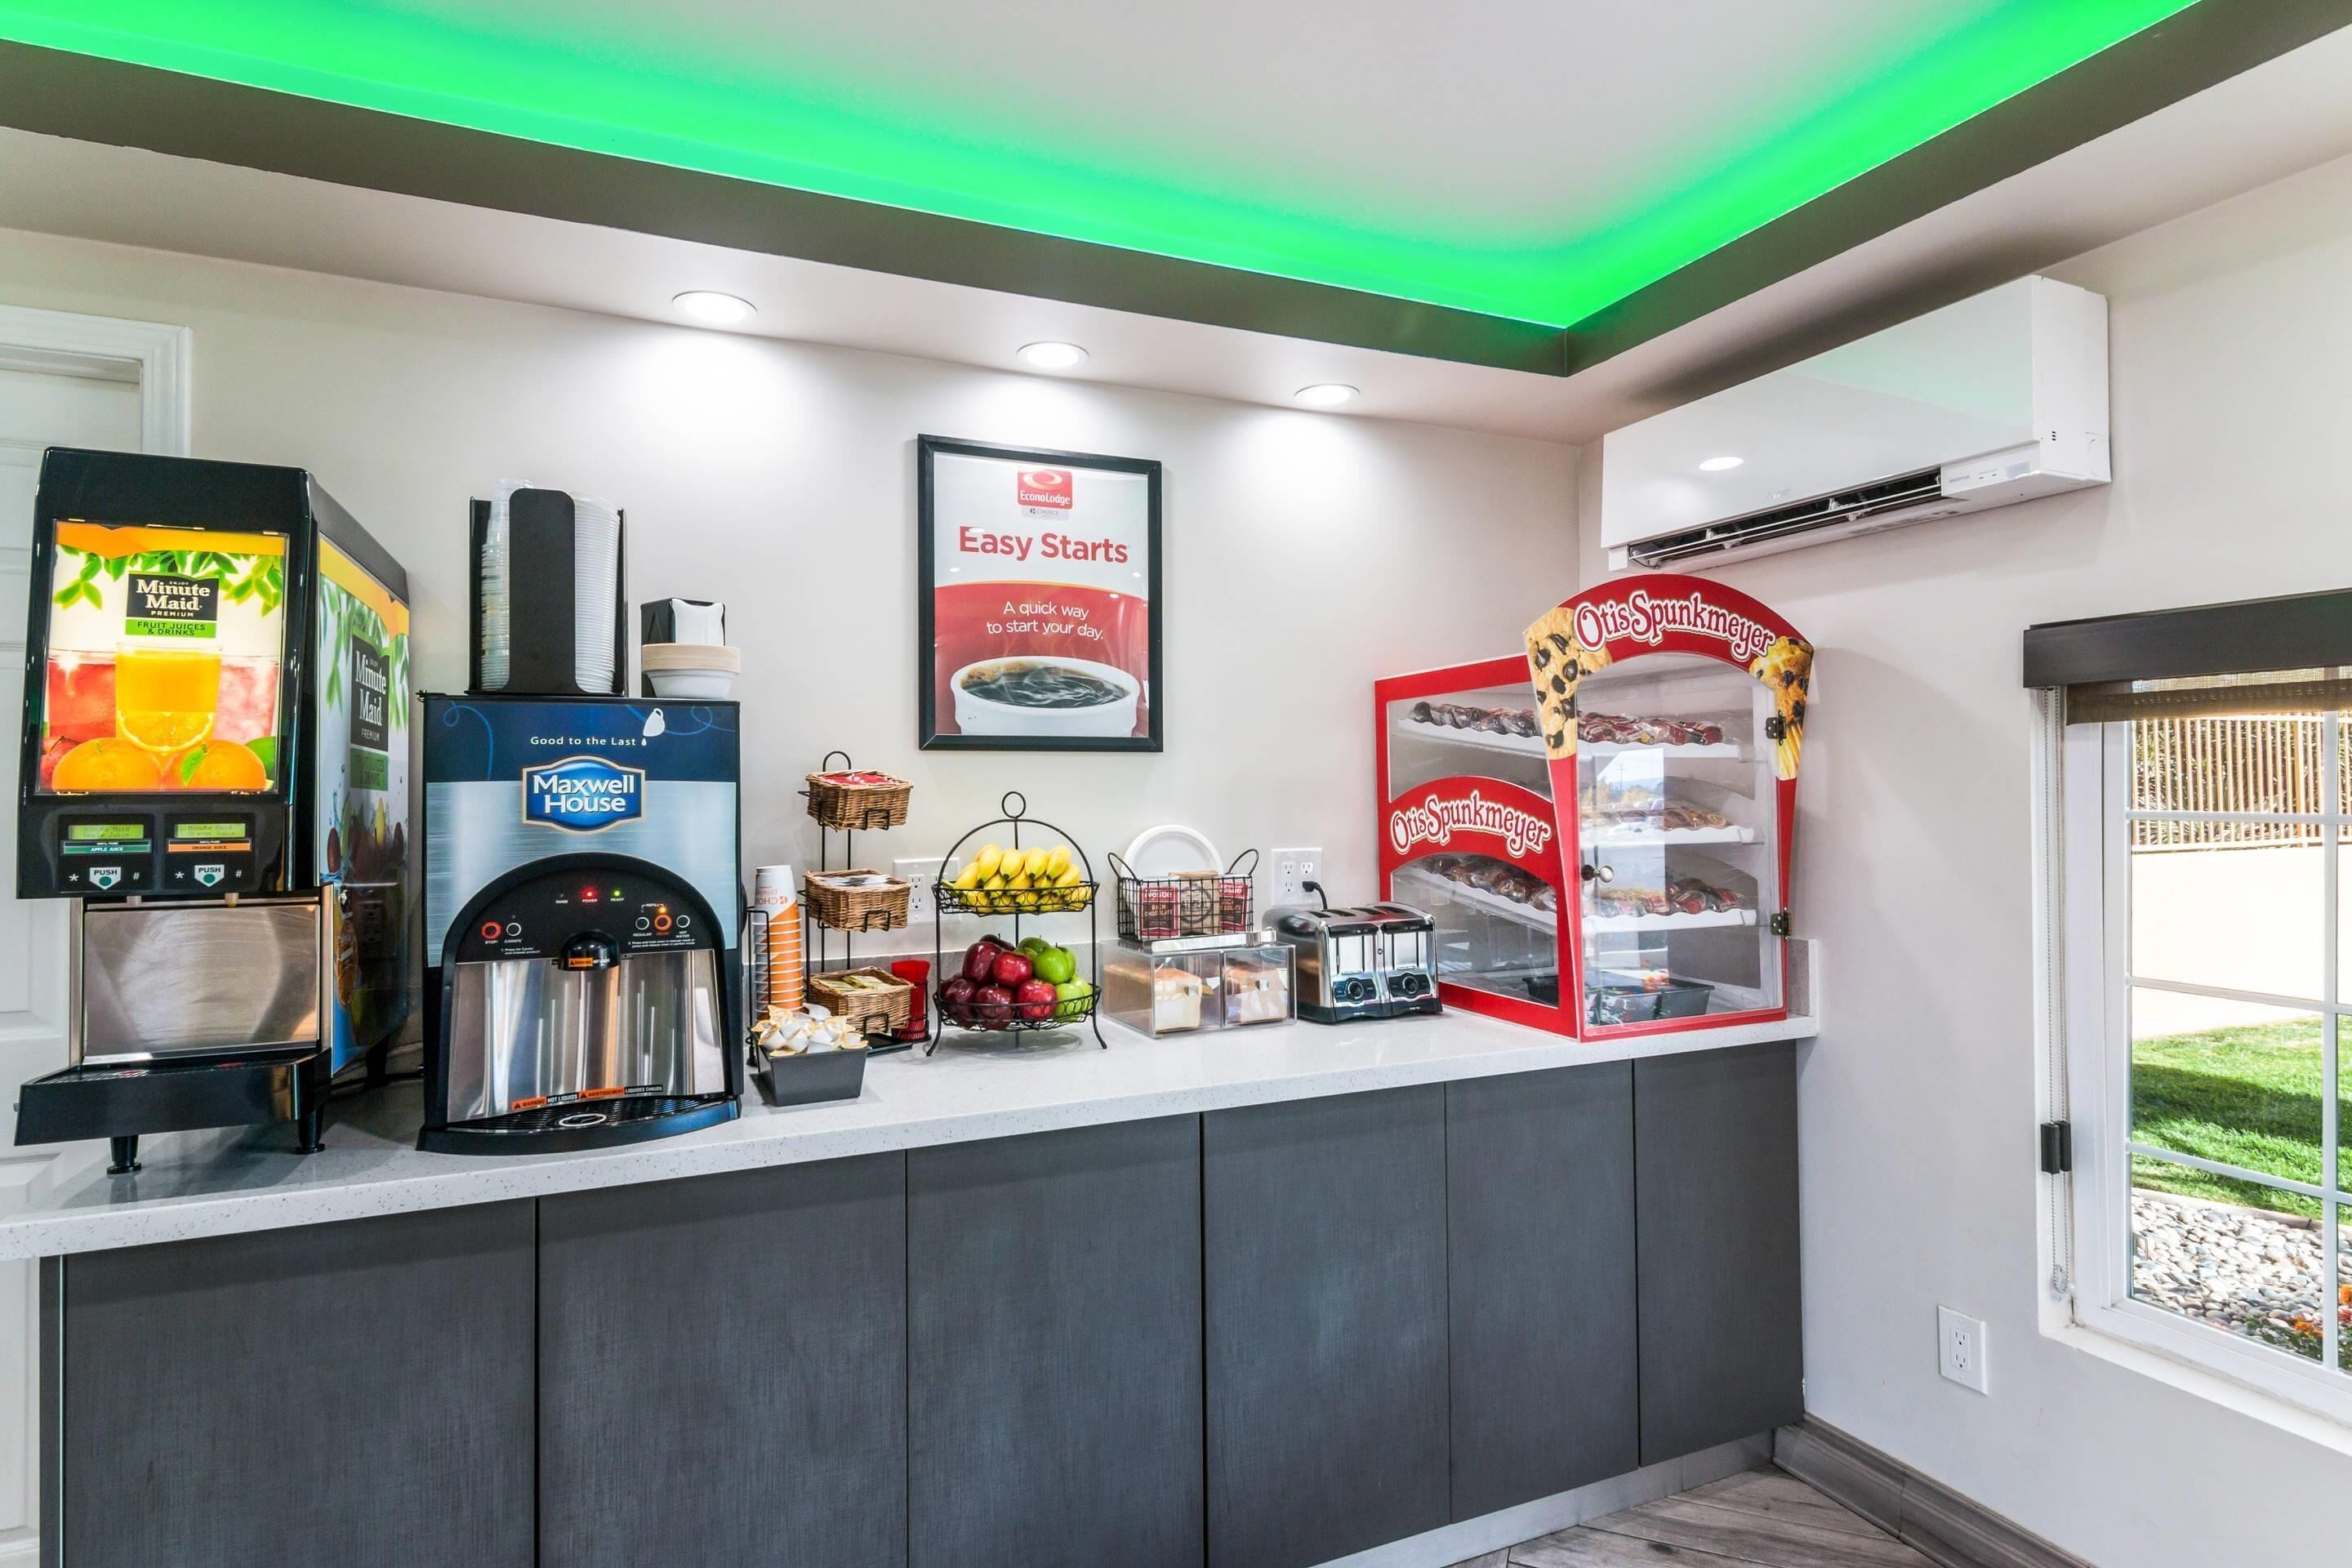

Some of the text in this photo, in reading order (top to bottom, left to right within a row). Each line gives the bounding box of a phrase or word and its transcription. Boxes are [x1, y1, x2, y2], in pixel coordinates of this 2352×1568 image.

[1020, 490, 1071, 506] EconoLodge
[960, 525, 1129, 564] Easy Starts
[136, 578, 212, 597] Minute
[145, 594, 200, 611] Maid
[1003, 601, 1089, 621] A quick way
[137, 621, 206, 630] FRUIT JUICES
[158, 628, 195, 636] DRINKS
[986, 619, 1103, 641] to start your day.
[1576, 593, 1775, 657] Otis Spunkmeyer
[355, 650, 386, 695] Minute
[359, 688, 382, 726] Maid
[530, 736, 564, 745] Good
[586, 737, 606, 745] the
[612, 737, 636, 746] Last
[532, 774, 635, 797] Maxwell
[544, 795, 627, 813] House
[1392, 791, 1550, 854] Otis Spunkmeyer
[558, 1094, 577, 1102] LIQUIDS
